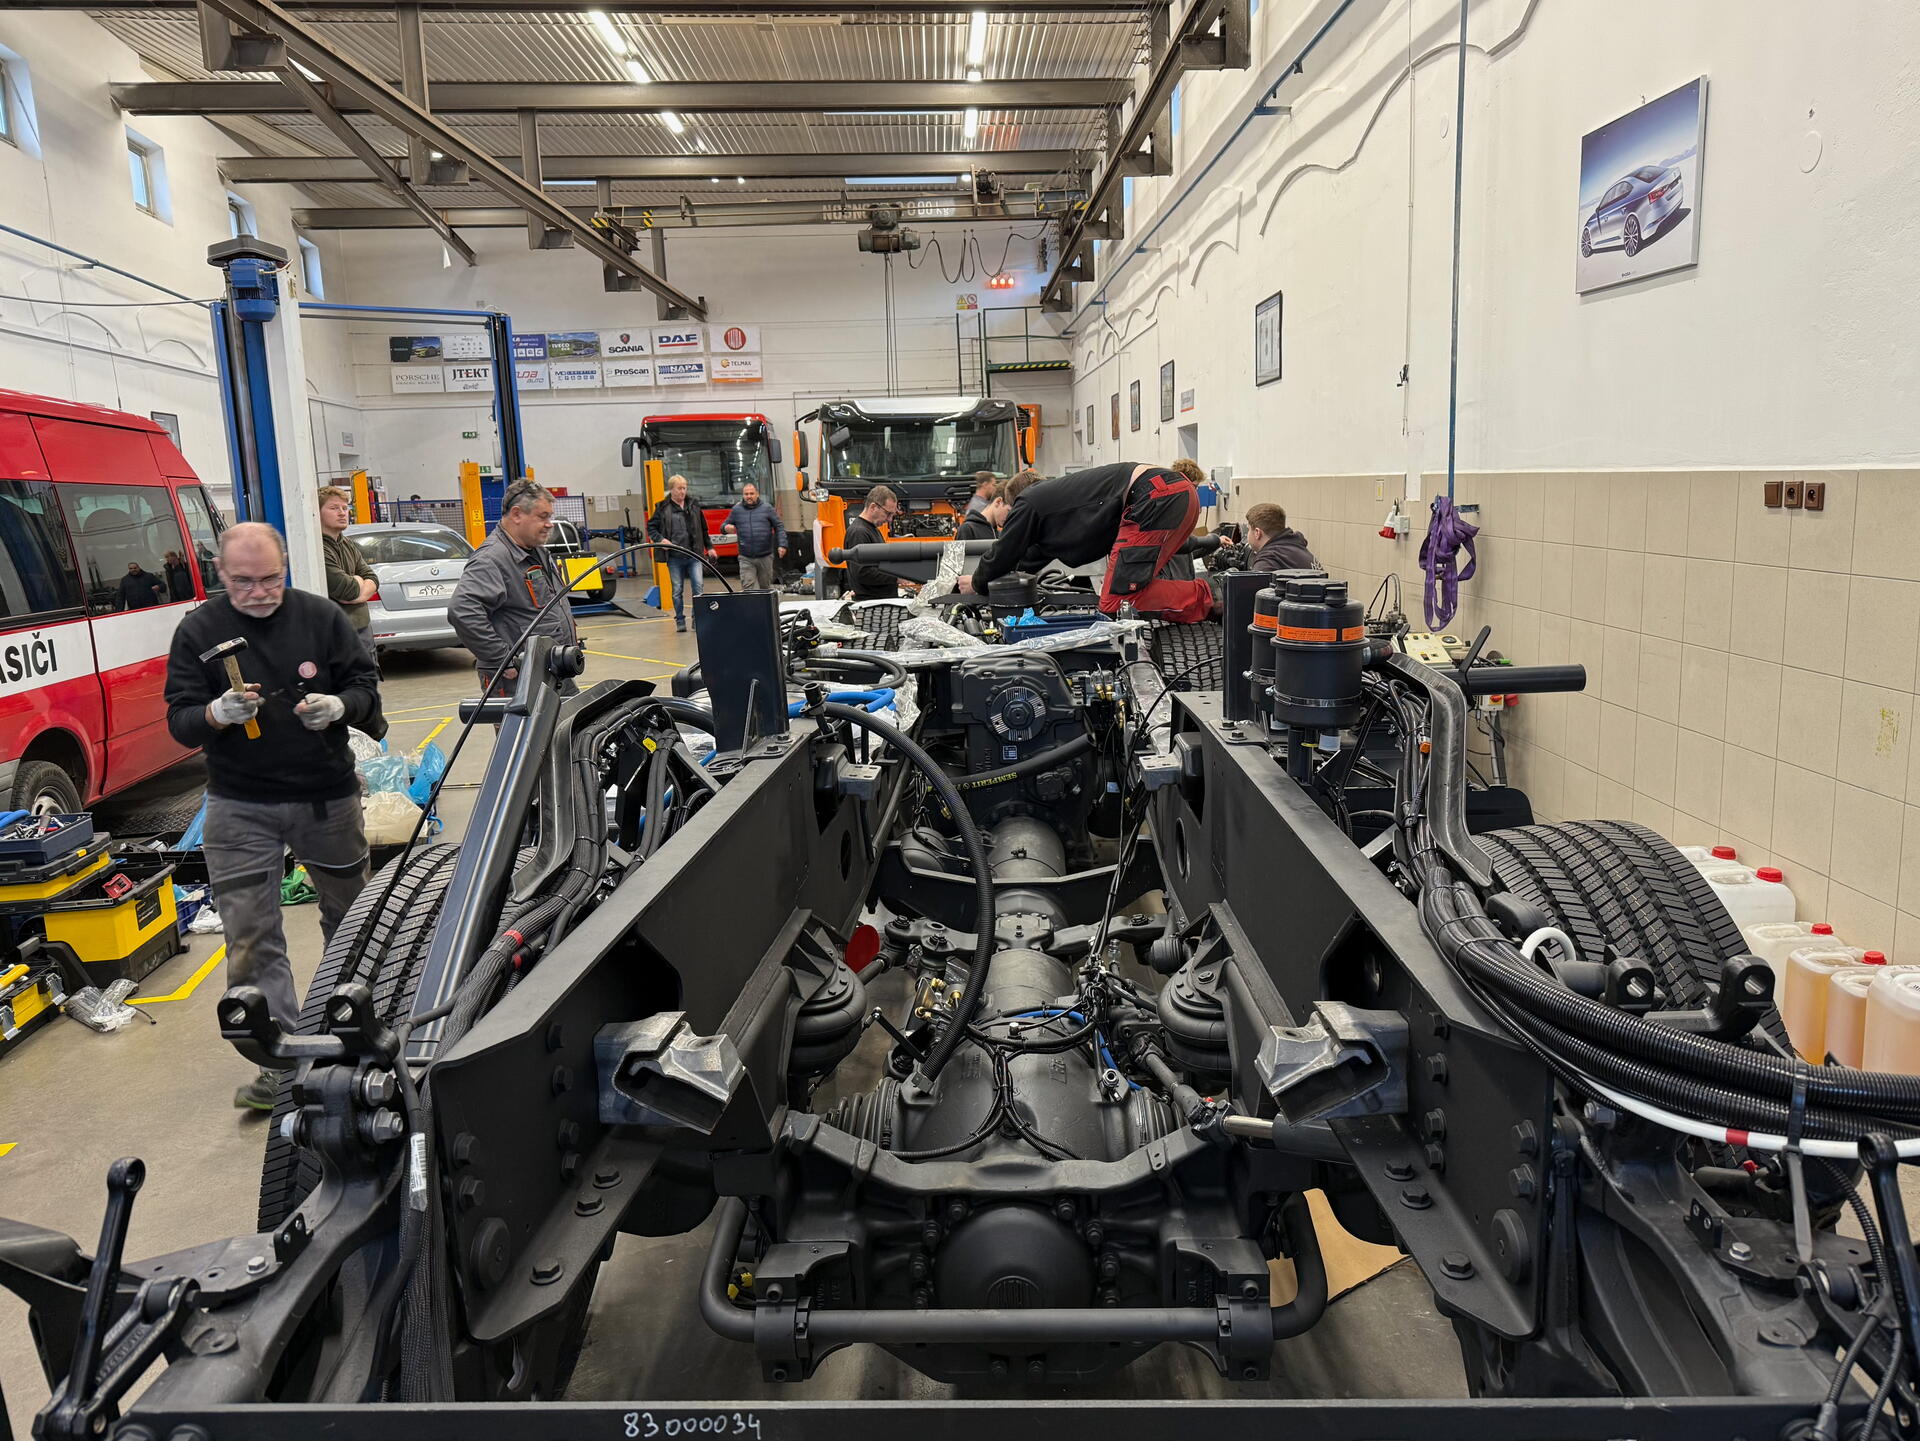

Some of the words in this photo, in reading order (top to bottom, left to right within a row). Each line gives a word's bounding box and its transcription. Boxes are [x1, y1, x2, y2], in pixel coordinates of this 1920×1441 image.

[822, 203, 872, 220] NOSNO
[658, 334, 697, 344] DAF
[608, 345, 645, 354] SCANIA
[670, 364, 699, 373] NAPA
[452, 368, 489, 381] JTEKT
[971, 772, 1018, 788] SEMPERIT
